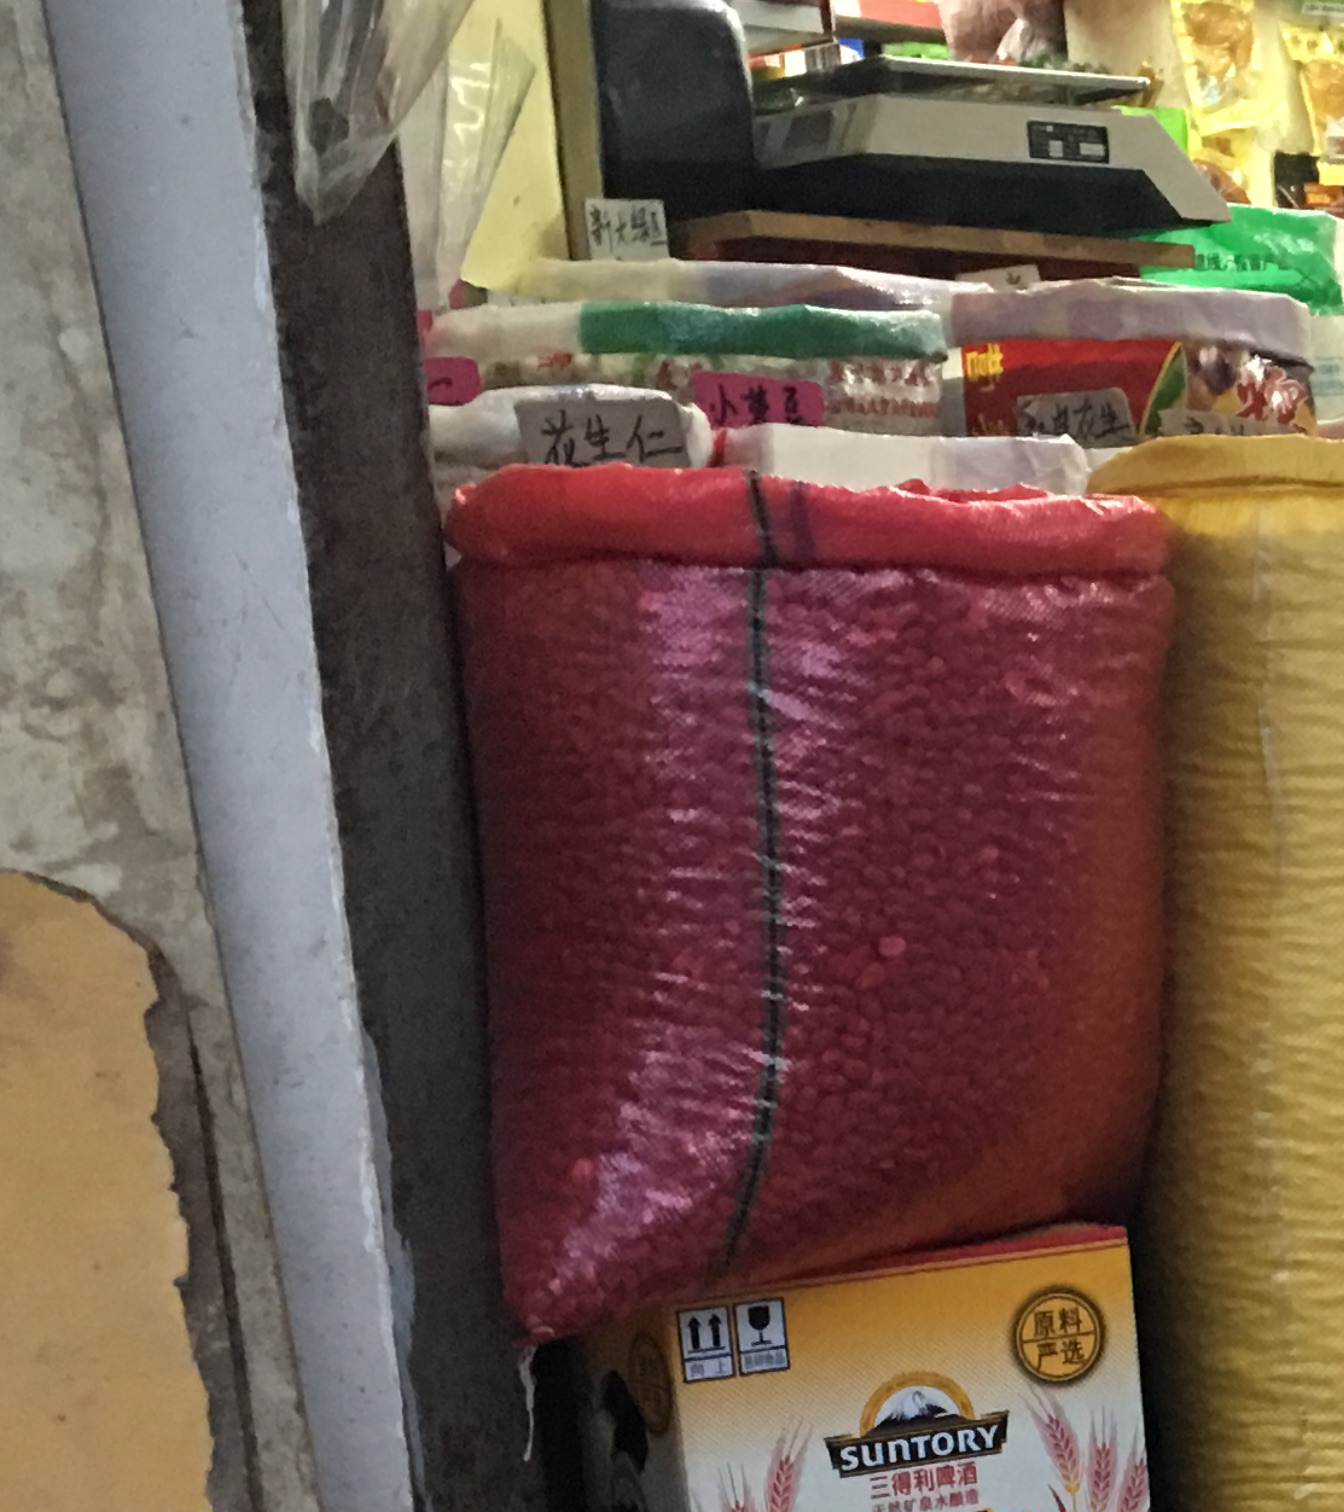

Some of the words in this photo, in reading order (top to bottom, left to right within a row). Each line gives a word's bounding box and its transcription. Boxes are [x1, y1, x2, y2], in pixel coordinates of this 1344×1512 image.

[542, 409, 686, 468] 花生仁
[1034, 1307, 1083, 1338] 原料
[1037, 1336, 1086, 1370] 严选
[839, 1424, 999, 1472] SUNTORY
[870, 1461, 979, 1500] 三得利啤酒
